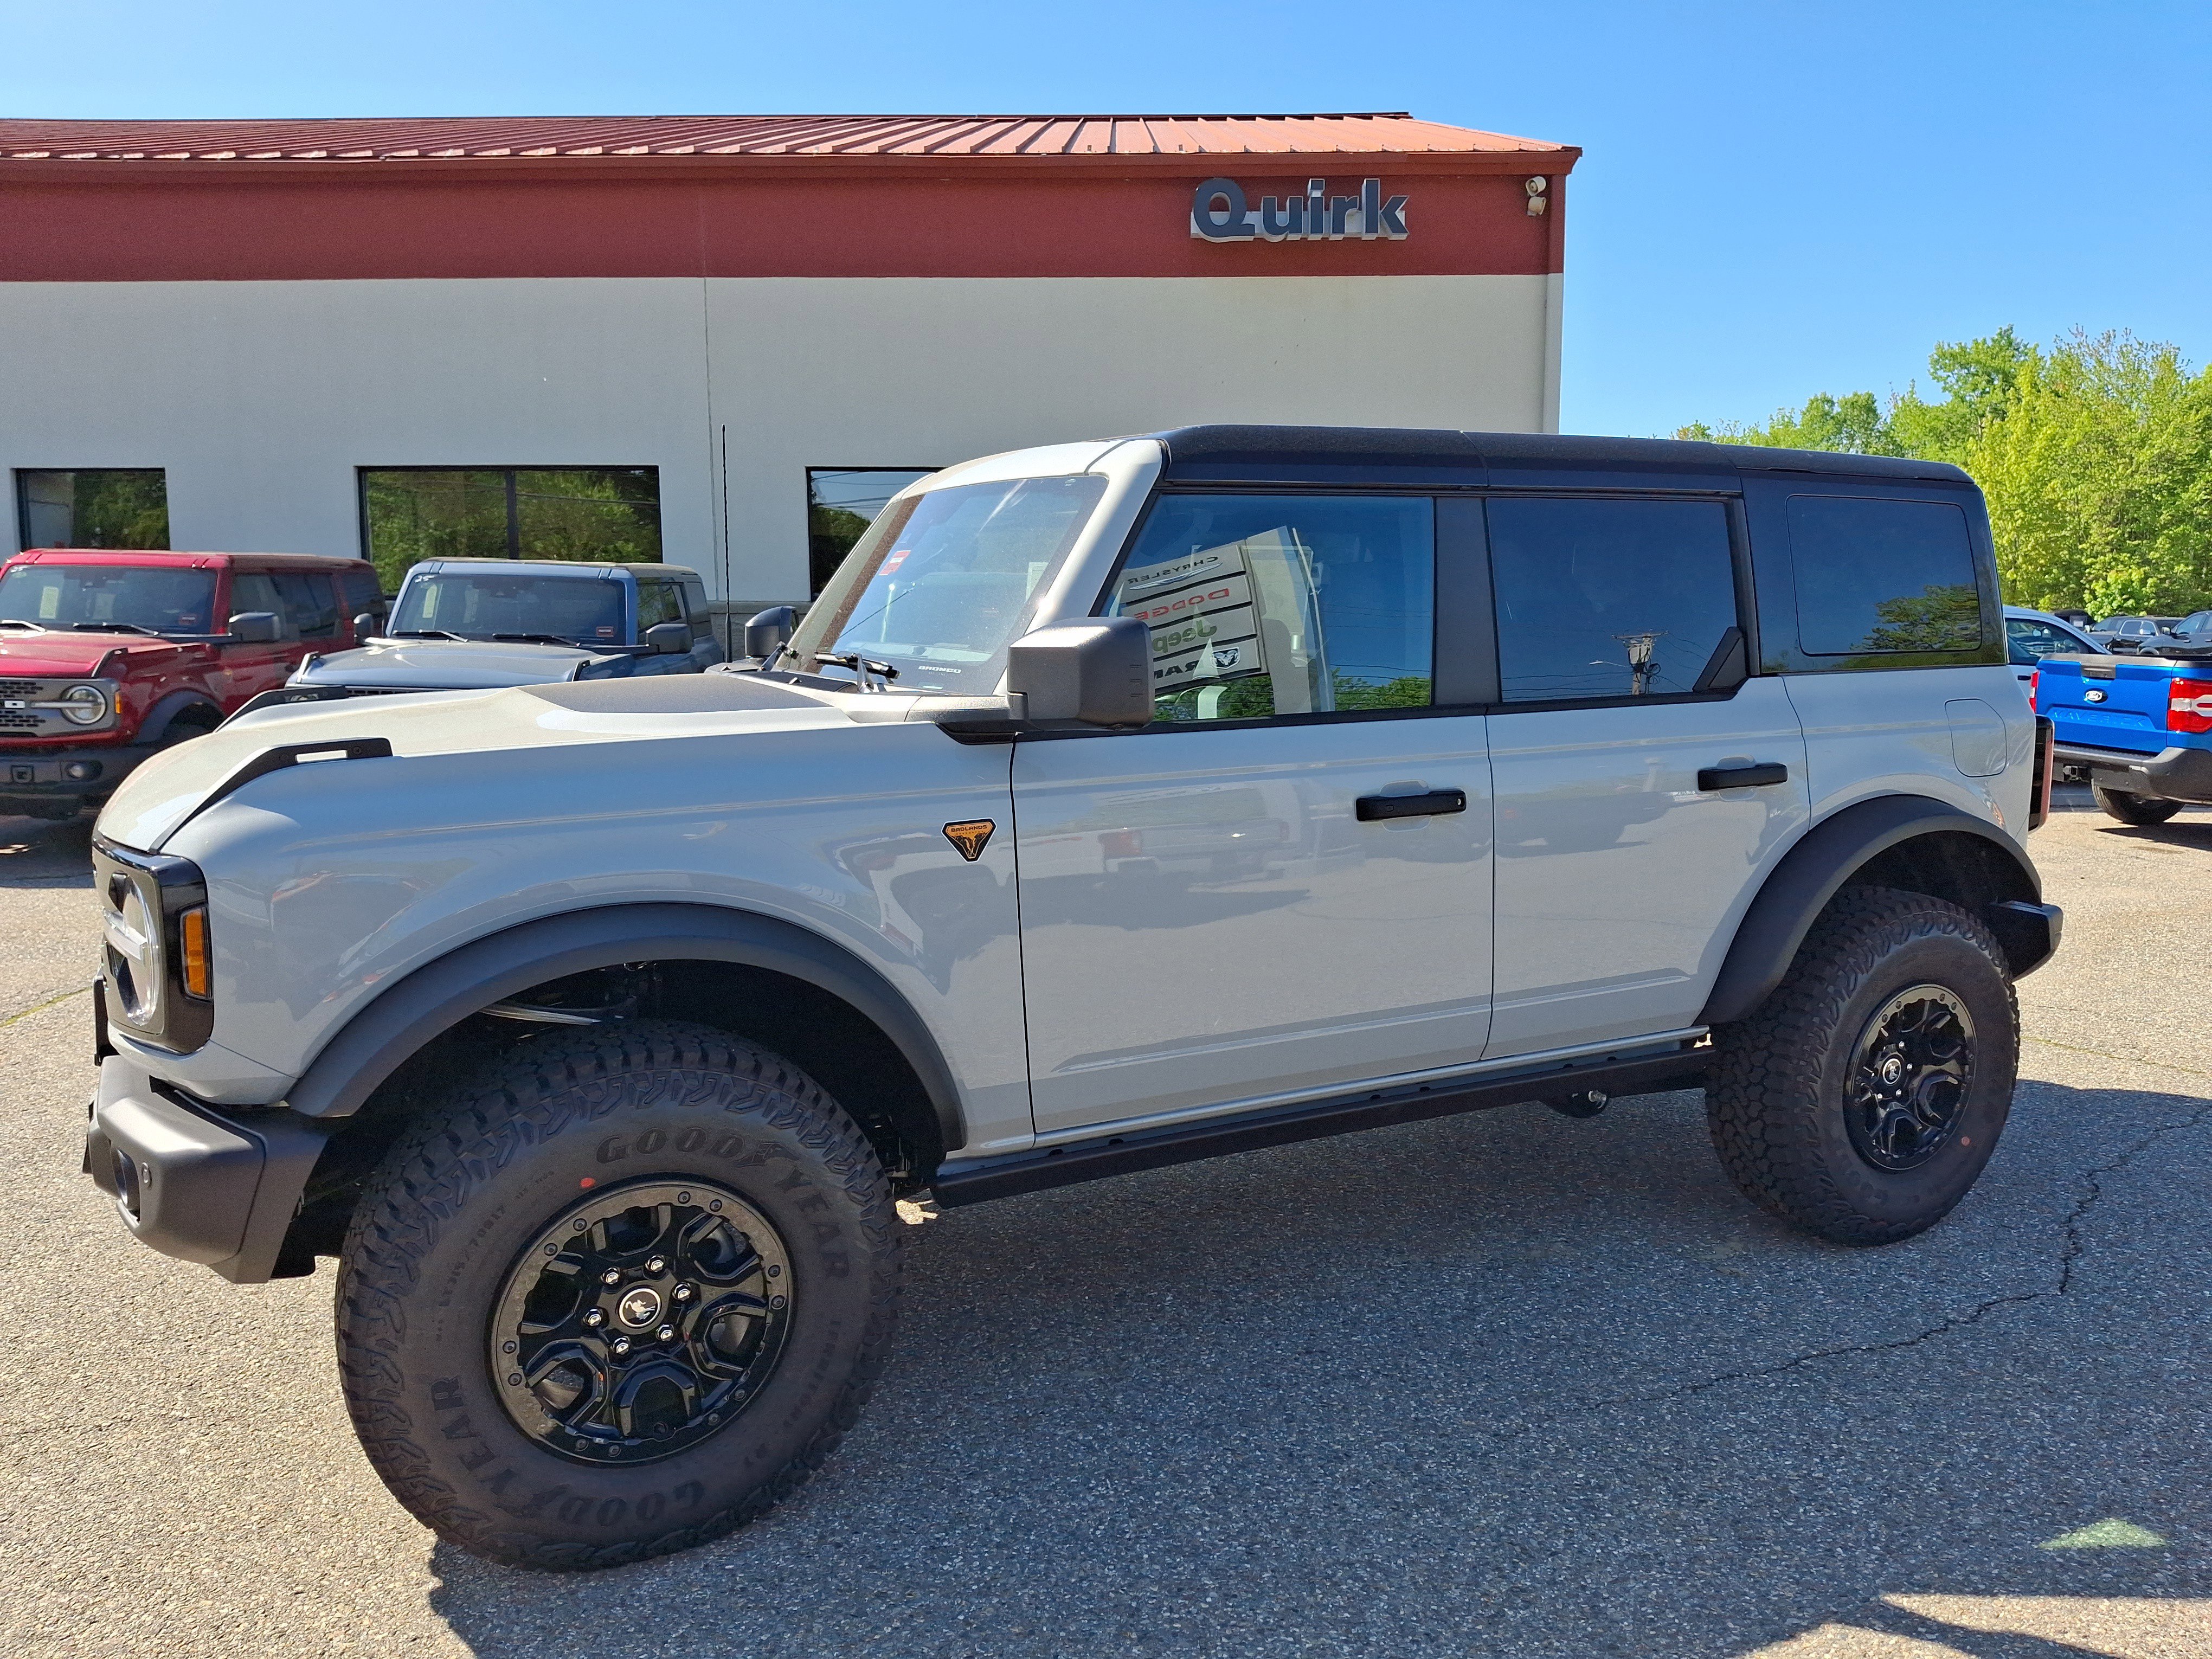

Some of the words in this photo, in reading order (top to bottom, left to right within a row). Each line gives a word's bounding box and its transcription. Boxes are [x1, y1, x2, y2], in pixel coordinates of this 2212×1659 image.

[1192, 177, 1409, 242] Quirk
[918, 665, 962, 673] BRONCO
[596, 1126, 850, 1279] GOODYEAR
[430, 1375, 705, 1527] GOODYEAR
